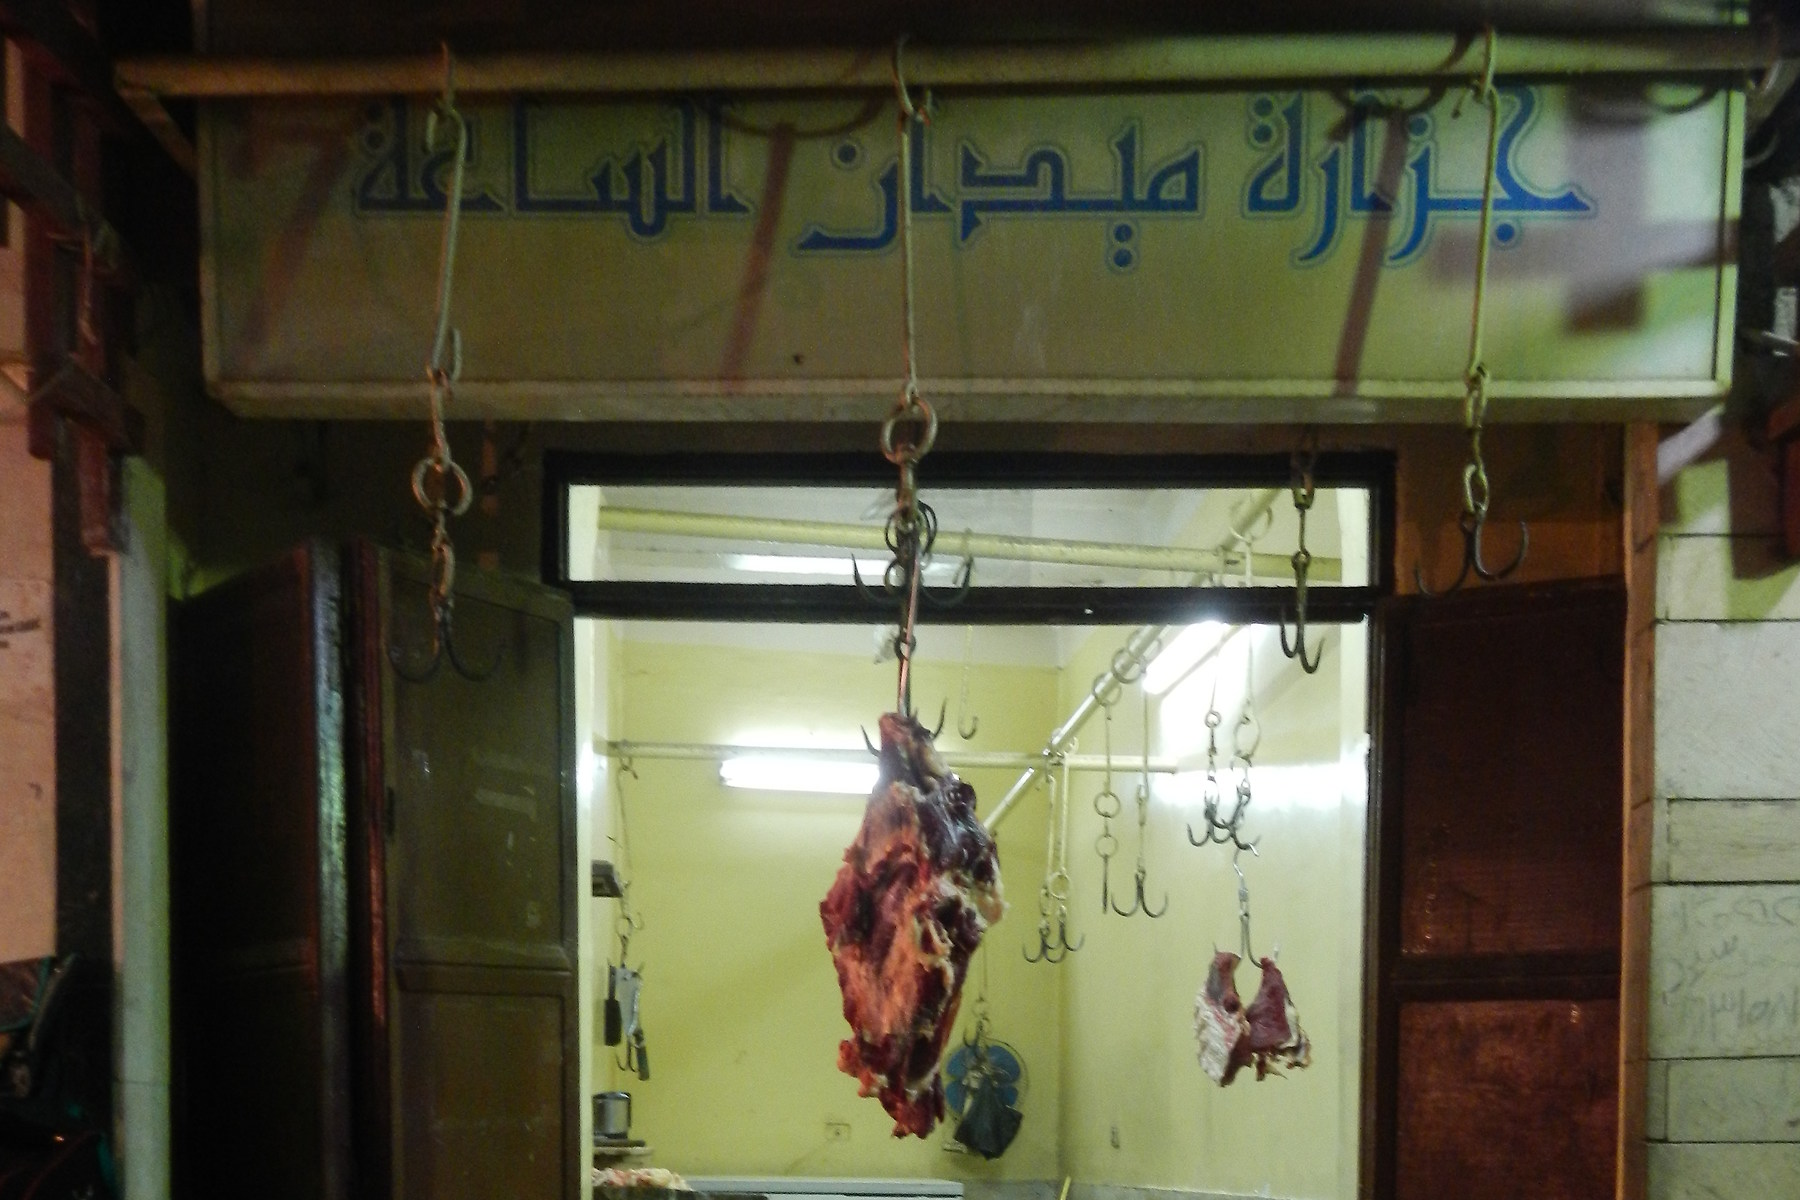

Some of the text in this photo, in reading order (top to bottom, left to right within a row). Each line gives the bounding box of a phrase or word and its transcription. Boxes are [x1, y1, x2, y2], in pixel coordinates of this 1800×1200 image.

[354, 86, 1592, 268] جزارة ميدان الساعة
